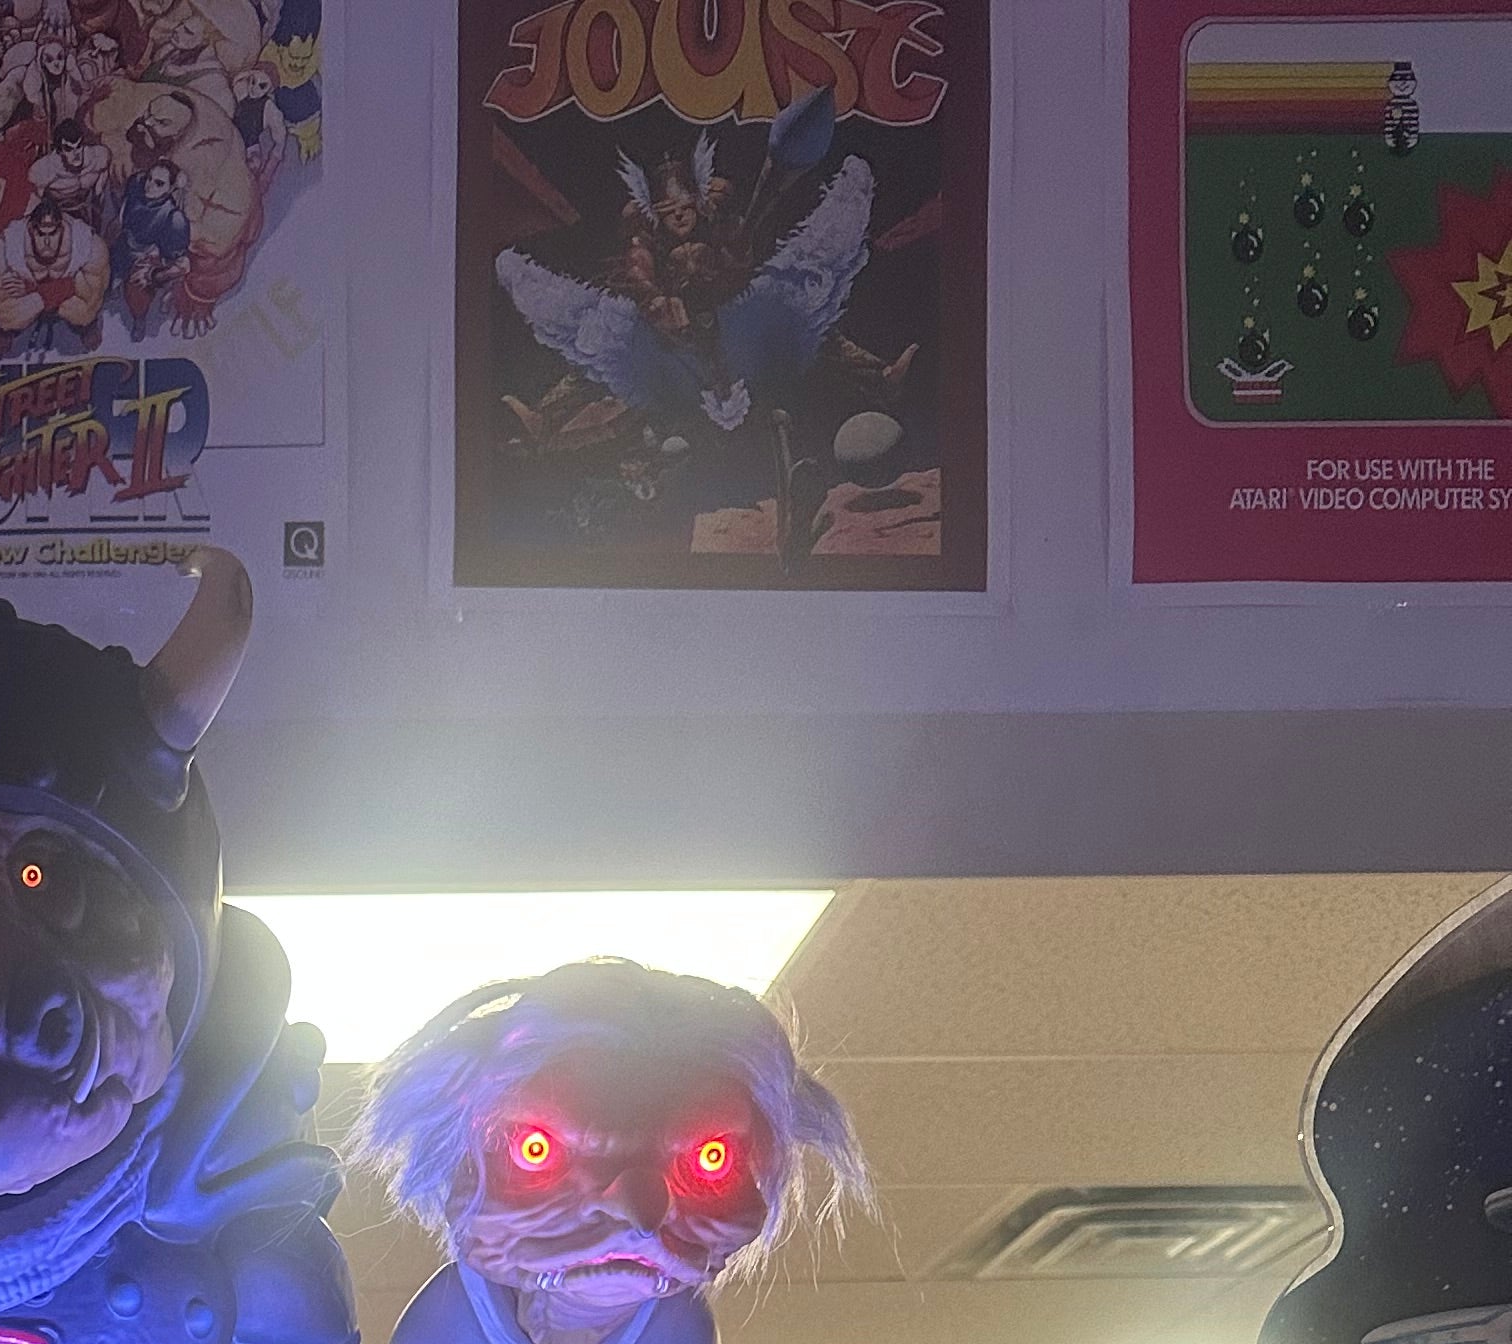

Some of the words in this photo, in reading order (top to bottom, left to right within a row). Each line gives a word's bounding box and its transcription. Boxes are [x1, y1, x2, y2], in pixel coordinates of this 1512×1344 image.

[483, 0, 948, 126] JOUST
[1307, 459, 1349, 480] FOR
[1354, 459, 1393, 480] USE
[1398, 459, 1452, 480] WITH
[1457, 459, 1495, 480] THE
[1229, 487, 1287, 510] ATARI
[1299, 487, 1364, 510] VIDEO
[1369, 487, 1484, 510] COMPUTER
[35, 538, 198, 566] Challenger
